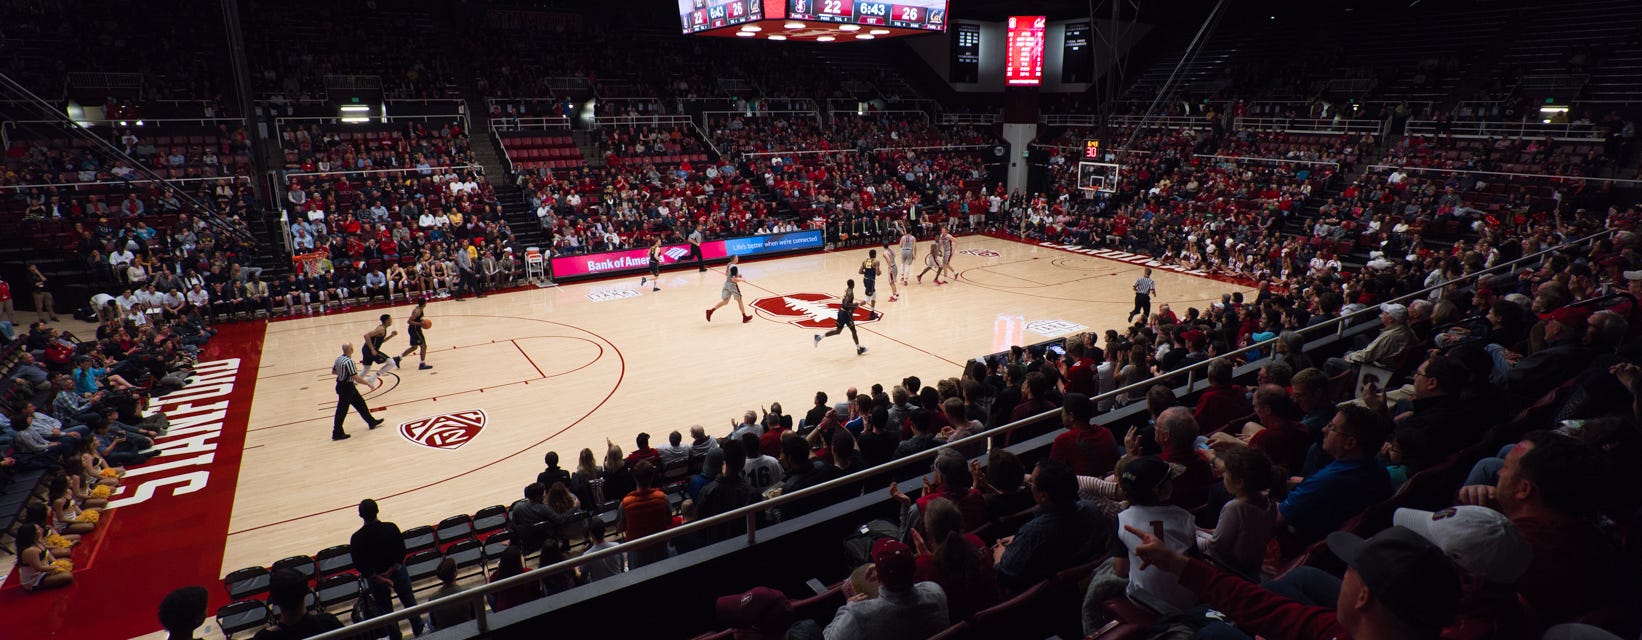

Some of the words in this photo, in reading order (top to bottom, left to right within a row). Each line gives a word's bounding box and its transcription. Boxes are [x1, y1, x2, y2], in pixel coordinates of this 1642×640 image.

[710, 6, 724, 19] 6:43
[732, 2, 743, 16] 26
[824, 0, 842, 14] 22
[860, 2, 885, 16] 6:43
[902, 7, 918, 21] 26
[694, 12, 703, 24] 22
[929, 9, 944, 23] Cal
[1086, 146, 1097, 158] 30
[747, 242, 764, 250] better
[764, 241, 779, 249] when
[792, 236, 818, 244] connected
[587, 259, 614, 271] Bank
[614, 257, 625, 268] of
[625, 255, 665, 267] Amera
